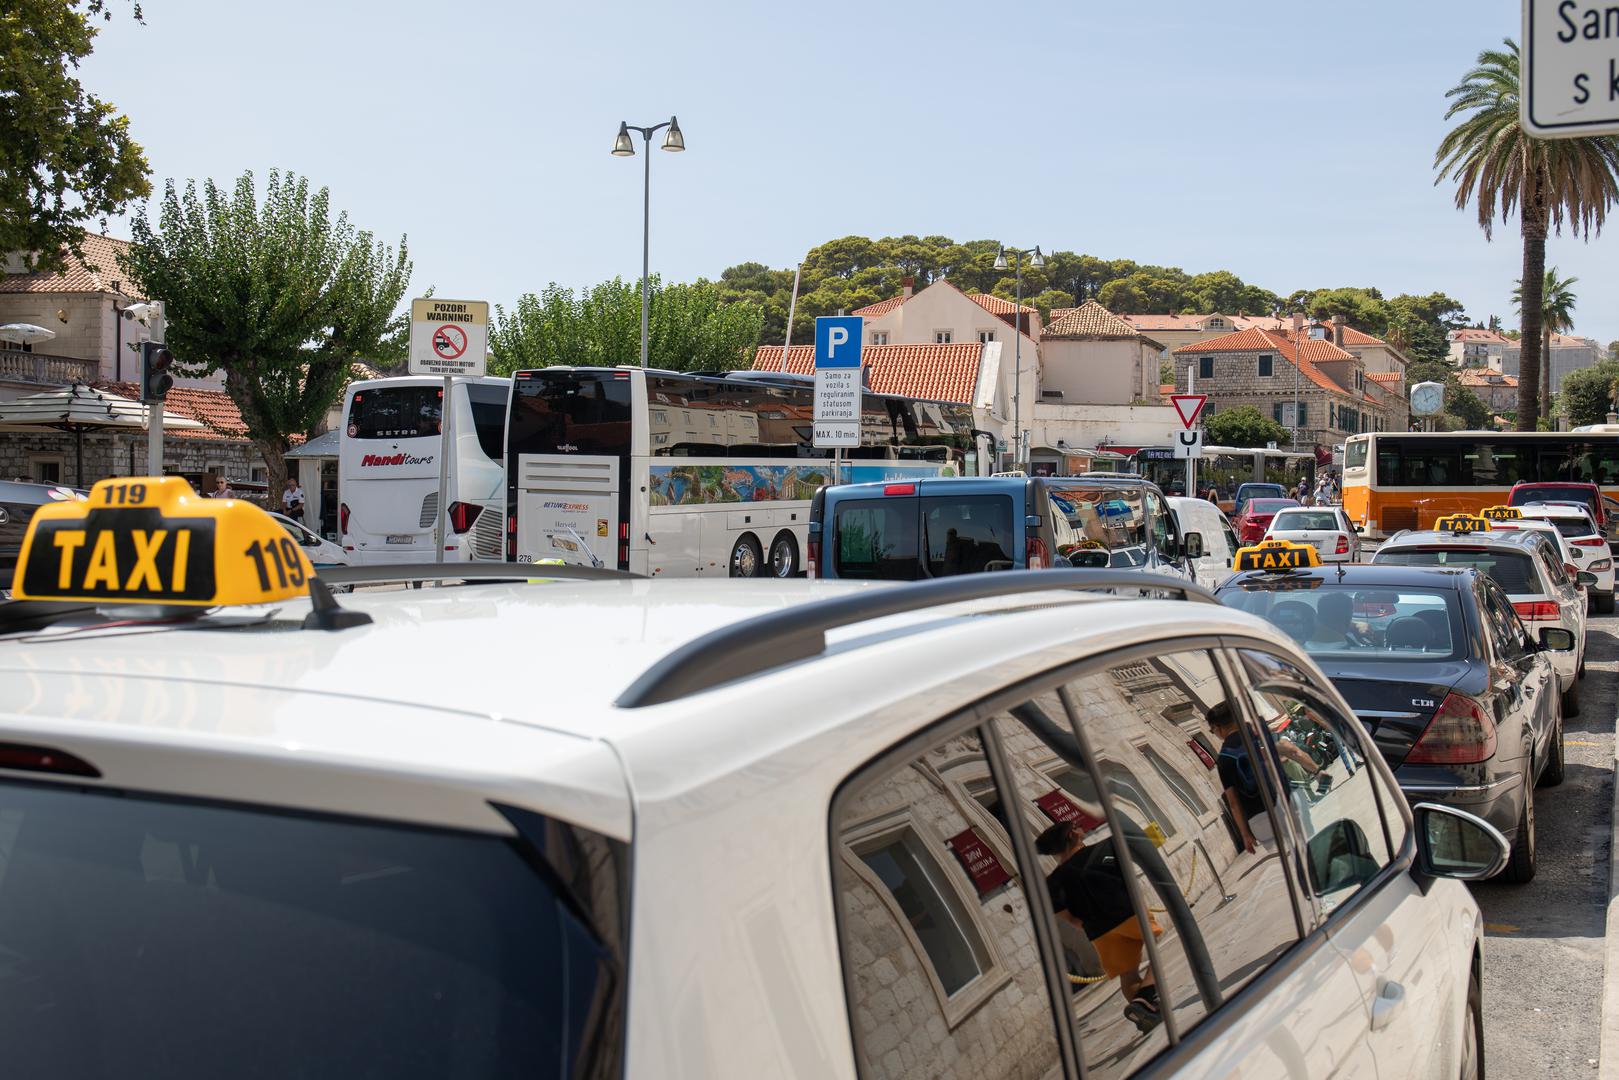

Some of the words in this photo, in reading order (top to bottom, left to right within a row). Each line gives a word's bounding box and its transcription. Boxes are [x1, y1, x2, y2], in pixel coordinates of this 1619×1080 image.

[1573, 72, 1590, 105] s
[434, 303, 467, 313] POZOR!
[426, 312, 473, 323] WARNING!
[828, 326, 849, 359] P
[825, 371, 841, 380] Samo
[825, 381, 844, 389] vozila
[820, 391, 855, 400] reguliranim
[822, 400, 852, 408] statusom
[821, 409, 853, 418] parkiranja
[376, 429, 418, 437] SETRA
[815, 430, 834, 439] MAX.
[835, 430, 843, 439] 10
[843, 431, 858, 439] min.
[102, 484, 147, 505] 119
[1488, 510, 1514, 519] TAXI
[1446, 520, 1480, 531] TAXI
[53, 529, 191, 593] TAXI
[519, 554, 532, 563] 278
[1249, 551, 1300, 569] TAXI
[245, 537, 304, 593] 119
[1412, 699, 1434, 707] CDI
